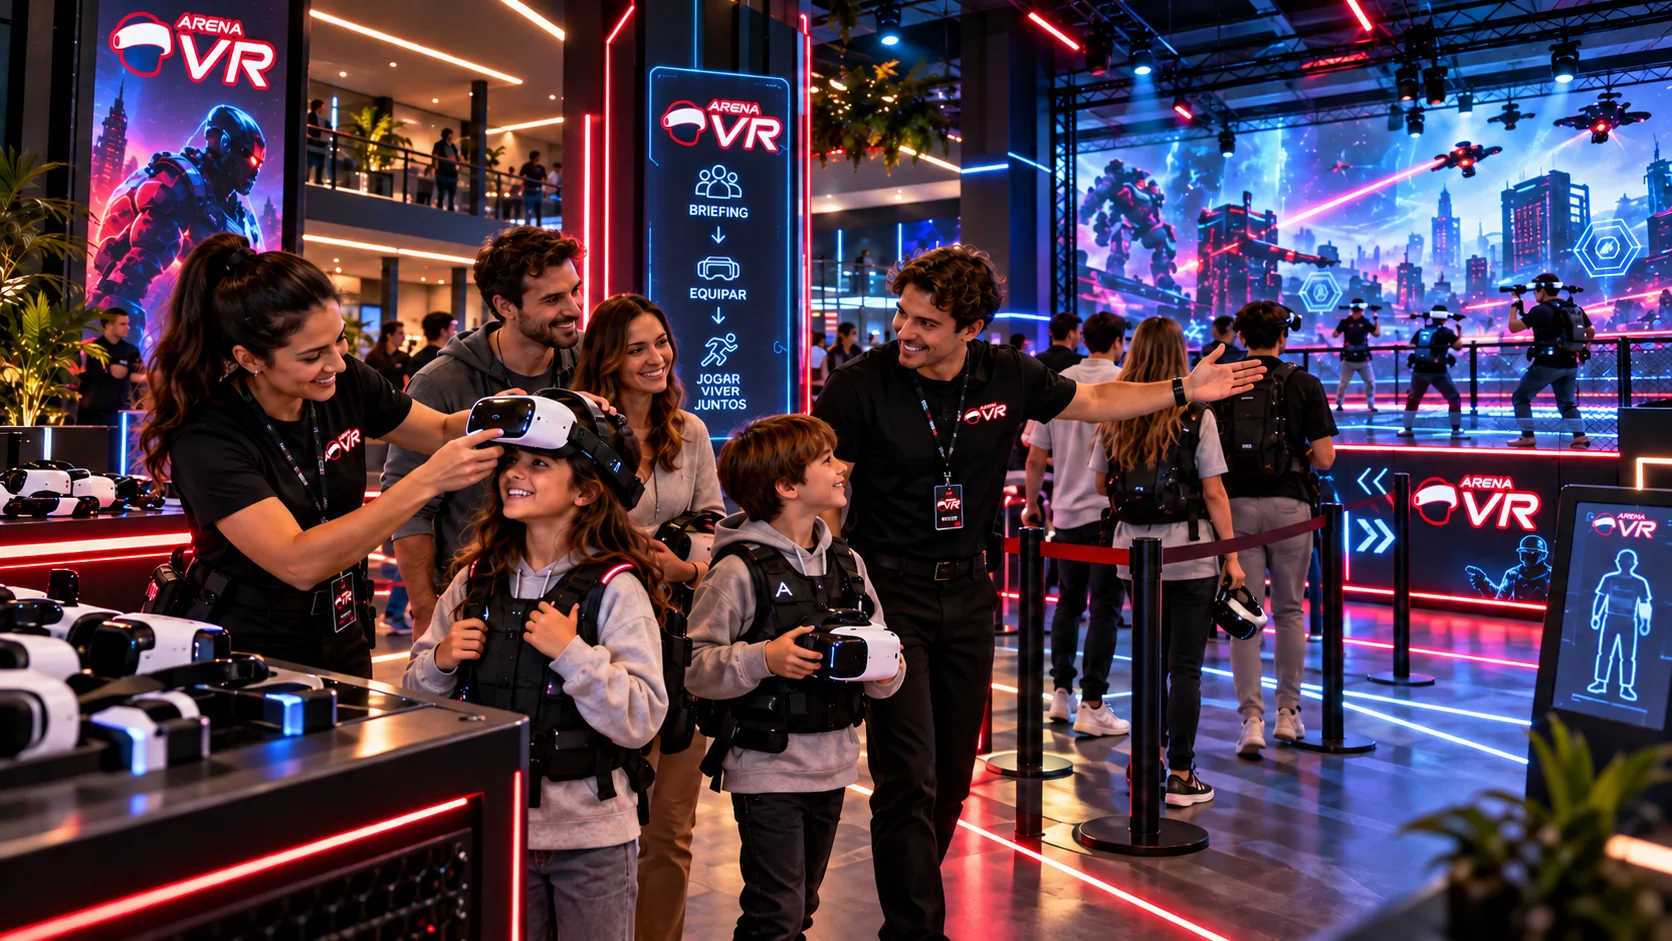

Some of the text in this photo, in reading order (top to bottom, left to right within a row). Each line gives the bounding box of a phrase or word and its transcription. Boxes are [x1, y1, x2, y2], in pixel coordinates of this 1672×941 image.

[177, 15, 242, 36] ARENA
[179, 34, 274, 88] VR
[707, 101, 760, 115] ARENA
[711, 114, 781, 151] VR
[689, 204, 749, 219] BRIEFING
[689, 287, 747, 301] EQUIPAR
[696, 373, 740, 385] JOGAR
[701, 386, 740, 396] VIVER
[694, 399, 747, 411] JUNTOS
[980, 404, 1006, 421] VR
[339, 429, 361, 452] VR
[1460, 477, 1513, 490] ARENA
[1462, 491, 1539, 530] VR
[1618, 519, 1658, 540] VR
[775, 581, 793, 598] A
